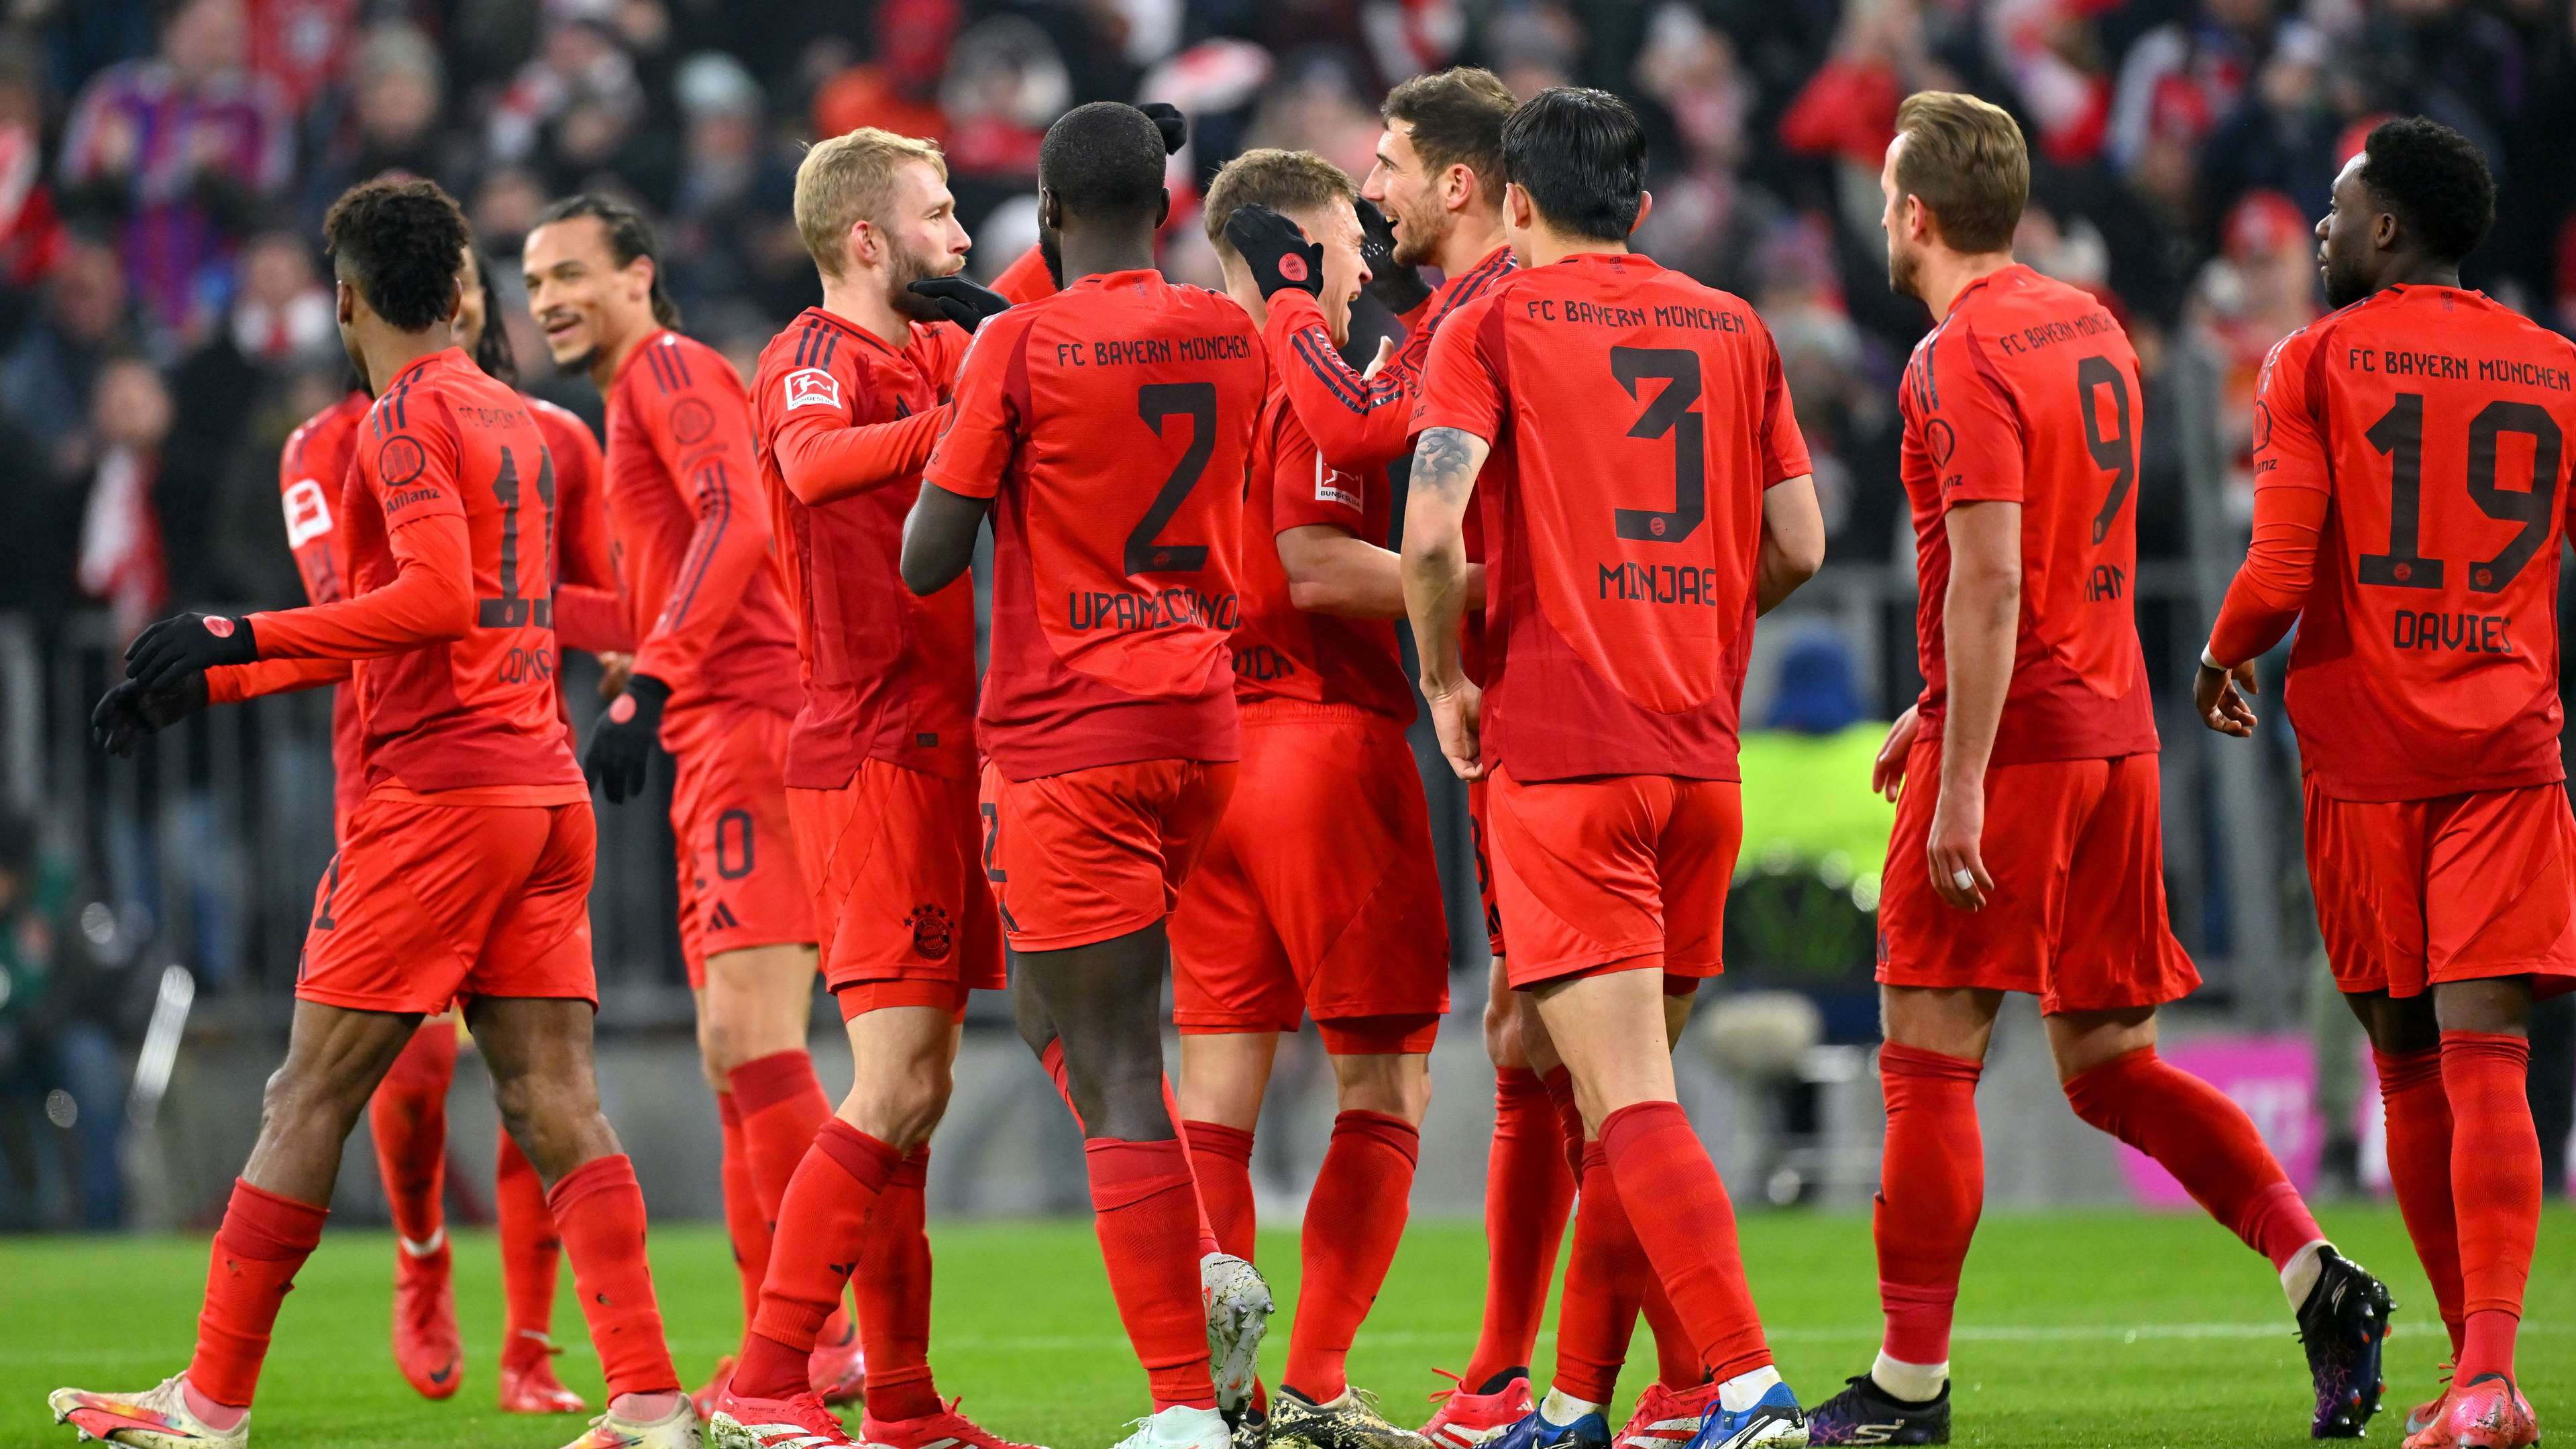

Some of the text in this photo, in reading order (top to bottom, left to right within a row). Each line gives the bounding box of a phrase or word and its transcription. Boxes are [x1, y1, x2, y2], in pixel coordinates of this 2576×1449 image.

[1527, 300, 1746, 334] FC BAYERN MÜNCHEN
[2000, 333, 2027, 356] FC
[2024, 321, 2077, 350] BAYERN
[1057, 334, 1250, 366] FC BAYERN MÜNCHEN
[2350, 348, 2571, 392] FC BAYERN MÜNCHEN
[1610, 345, 1705, 543] 3
[2078, 356, 2134, 546] 9
[1124, 381, 1218, 578] 2
[1320, 490, 1360, 507] BUNDESLIGA
[2357, 392, 2563, 594] 19
[386, 489, 440, 516] Allianz
[477, 445, 555, 629] 11
[1599, 562, 1716, 606] MINJAE
[1069, 588, 1238, 631] UPAMECANO
[2394, 609, 2512, 653] DAVIES
